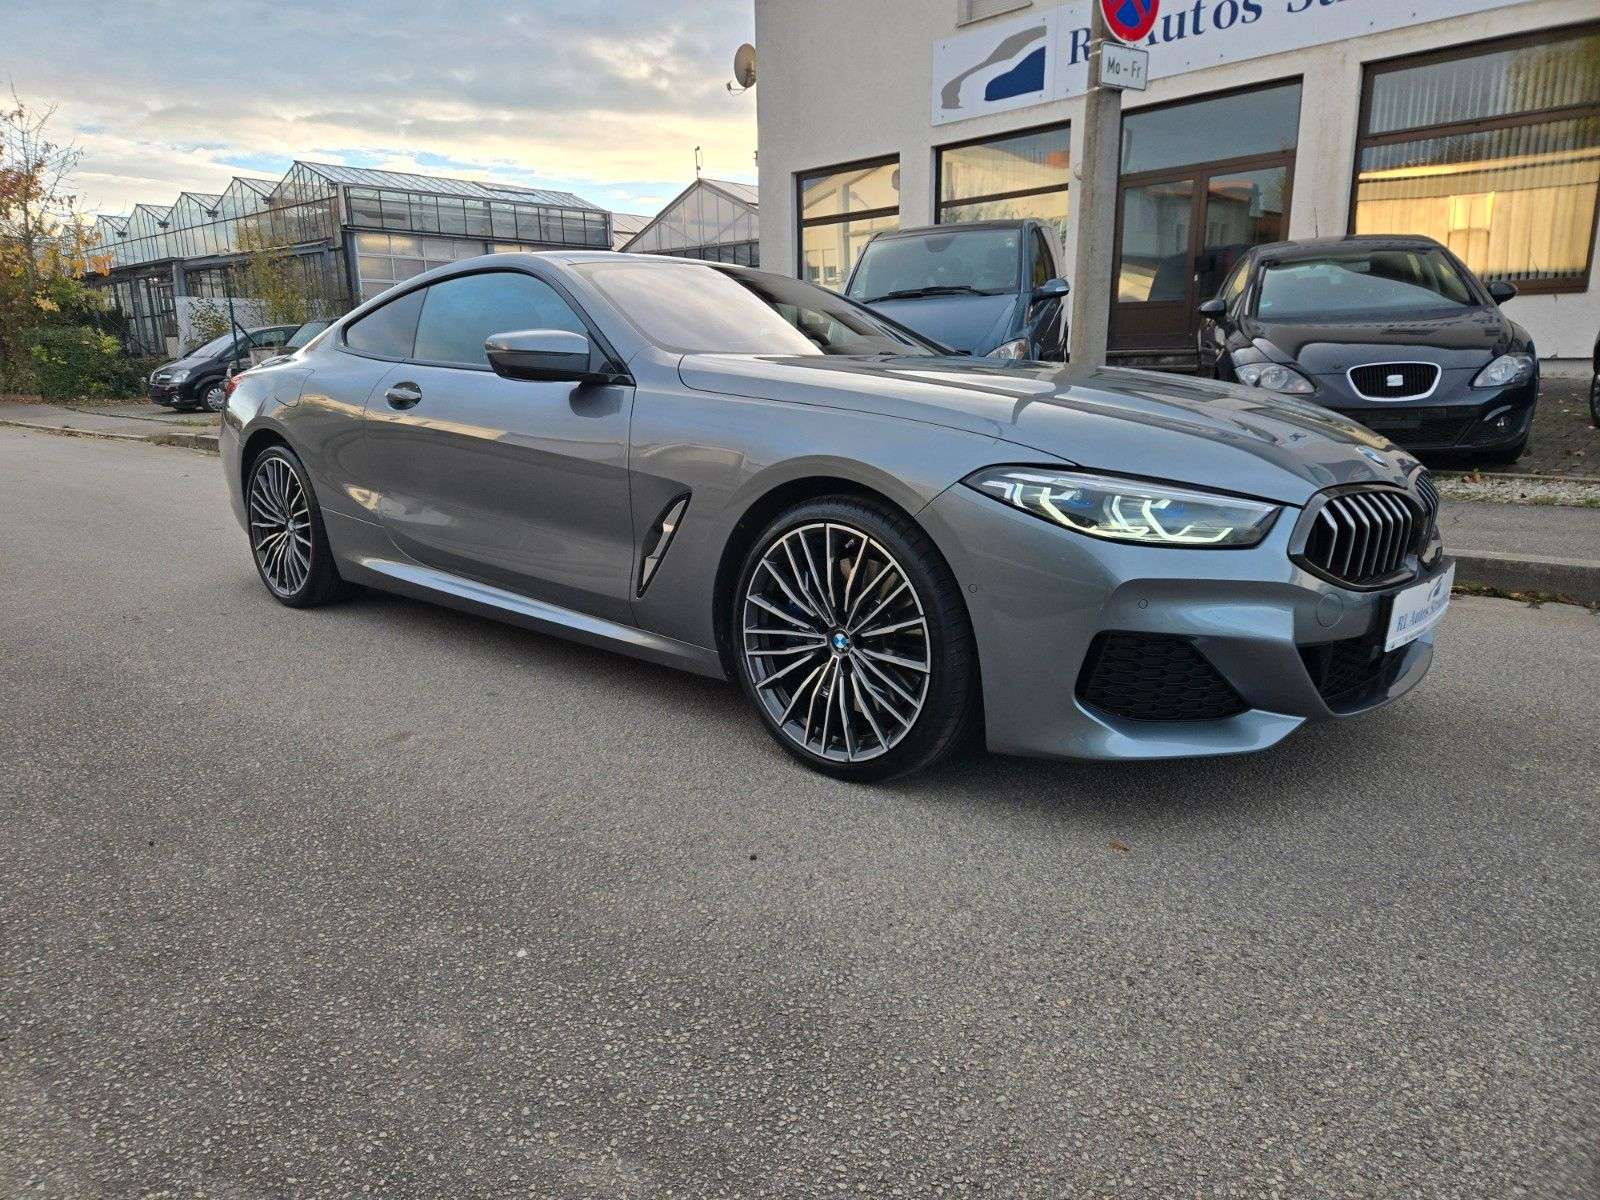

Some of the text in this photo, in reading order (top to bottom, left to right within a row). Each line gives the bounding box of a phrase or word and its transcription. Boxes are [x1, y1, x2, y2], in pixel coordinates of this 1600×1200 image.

[1146, 0, 1263, 46] utos
[1106, 56, 1120, 75] Mo
[1131, 60, 1141, 78] Fr
